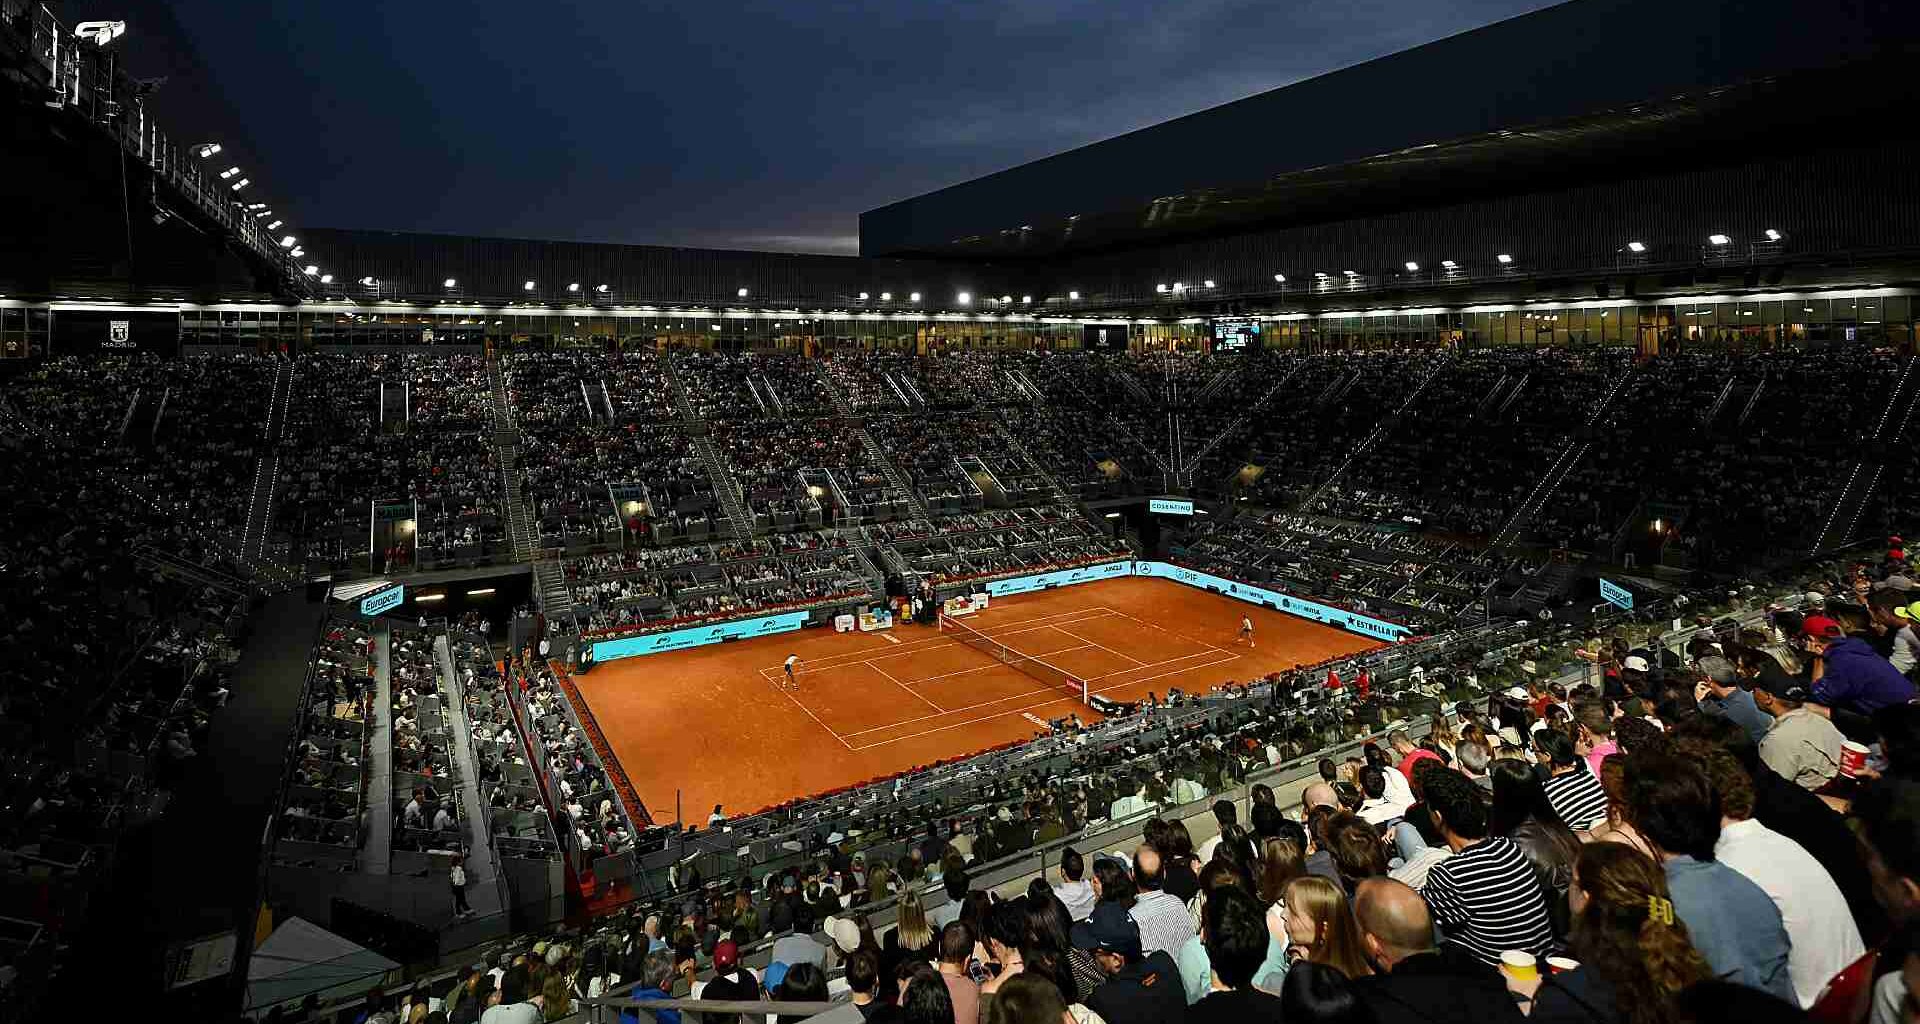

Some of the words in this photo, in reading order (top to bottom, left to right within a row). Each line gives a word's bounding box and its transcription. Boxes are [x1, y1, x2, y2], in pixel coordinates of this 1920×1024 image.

[101, 341, 137, 349] MADRID
[1151, 503, 1191, 512] COSENTINO
[1184, 571, 1198, 582] PIF
[1602, 583, 1630, 604] Europcar
[366, 591, 400, 611] Europcar
[1356, 621, 1392, 637] ESTRELLA
